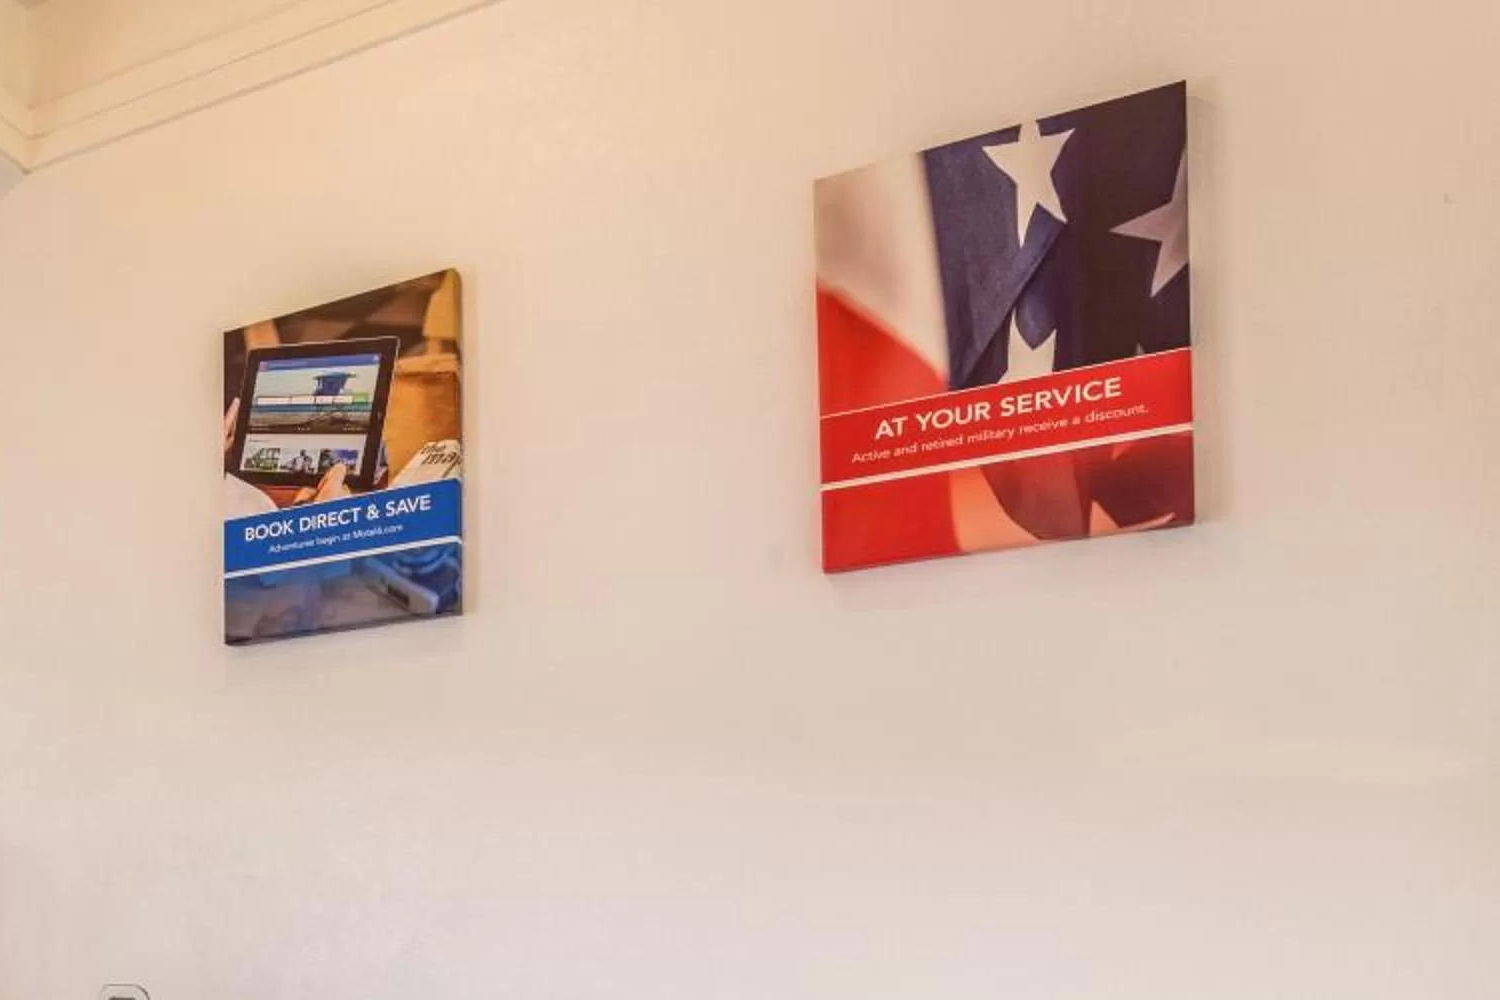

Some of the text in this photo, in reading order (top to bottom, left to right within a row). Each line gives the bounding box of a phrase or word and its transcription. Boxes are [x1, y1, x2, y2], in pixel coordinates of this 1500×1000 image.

[851, 403, 1150, 464] Active and retired military receive a discount.
[875, 376, 1123, 440] AT YOUR SERVICE
[244, 494, 432, 542] BOOK DIRECT & SAVE
[316, 533, 342, 547] begin
